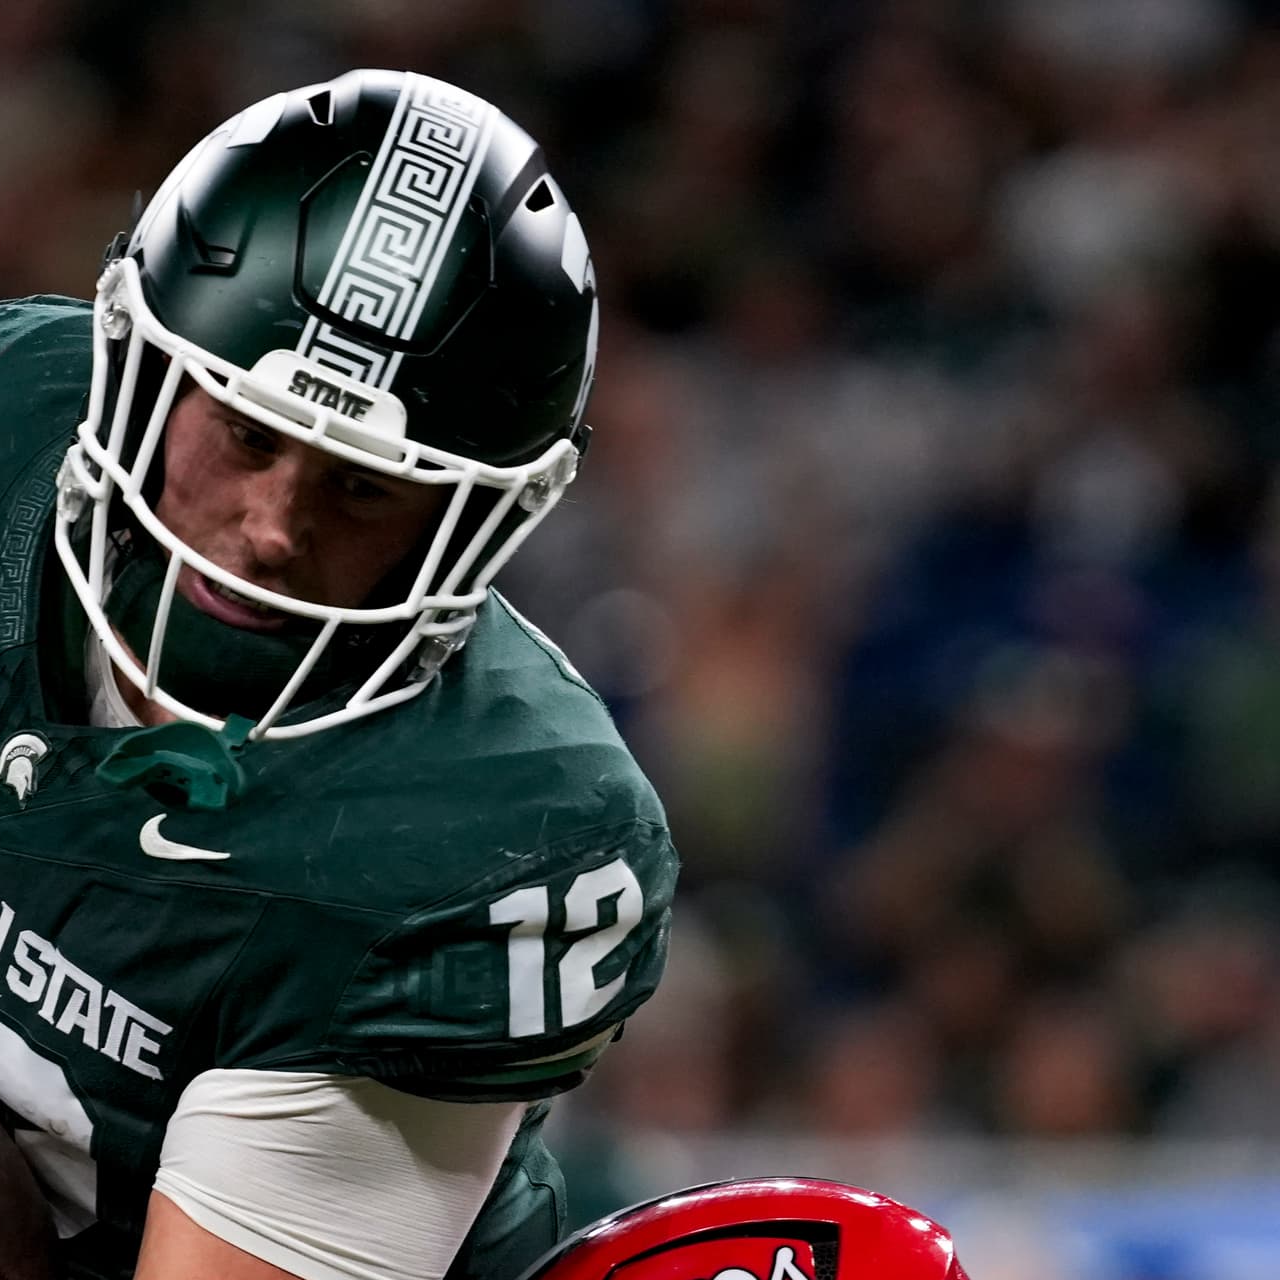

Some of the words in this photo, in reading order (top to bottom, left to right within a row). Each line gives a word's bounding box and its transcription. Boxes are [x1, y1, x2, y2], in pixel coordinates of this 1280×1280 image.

[287, 369, 375, 423] STATE
[5, 929, 174, 1081] STATE
[489, 858, 643, 1038] 12
